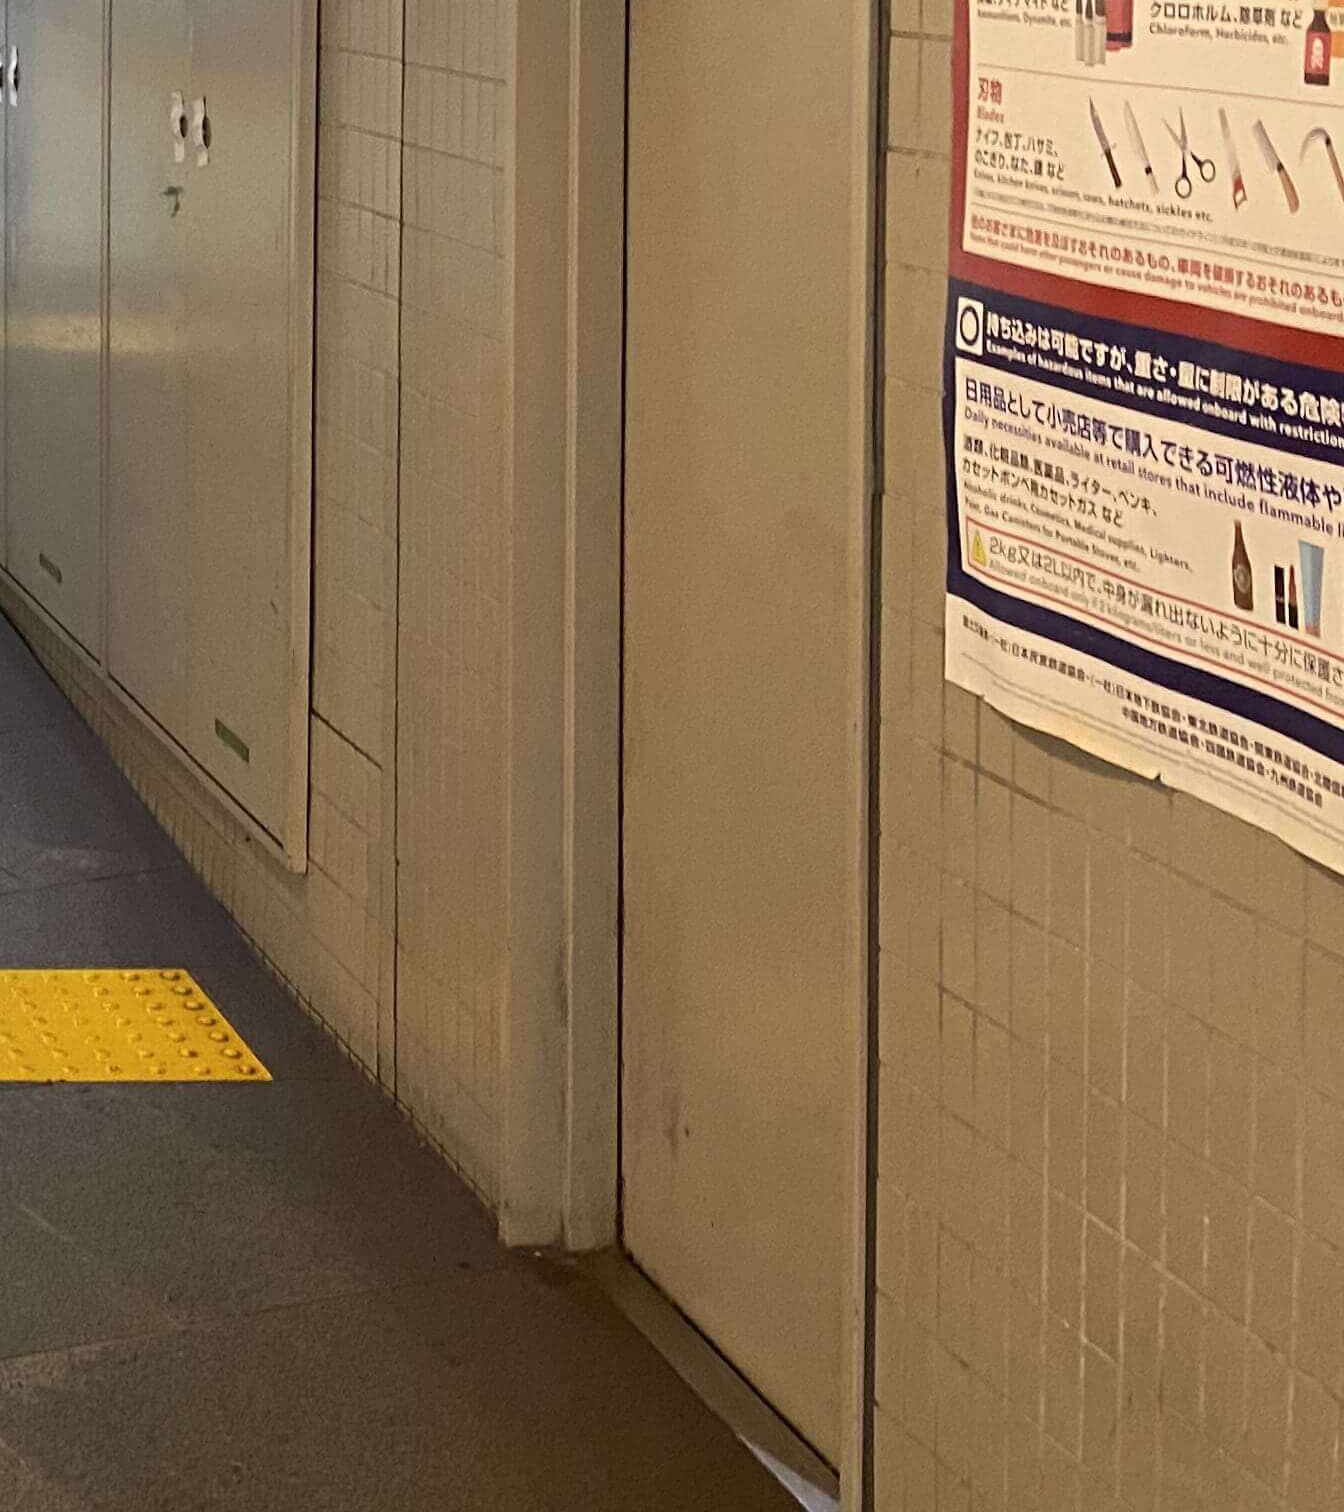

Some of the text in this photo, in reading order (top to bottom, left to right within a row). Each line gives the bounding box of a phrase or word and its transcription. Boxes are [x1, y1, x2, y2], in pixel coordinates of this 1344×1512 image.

[1248, 414, 1277, 433] with
[1175, 477, 1201, 497] that
[1204, 484, 1256, 512] include
[1259, 497, 1335, 536] flammable
